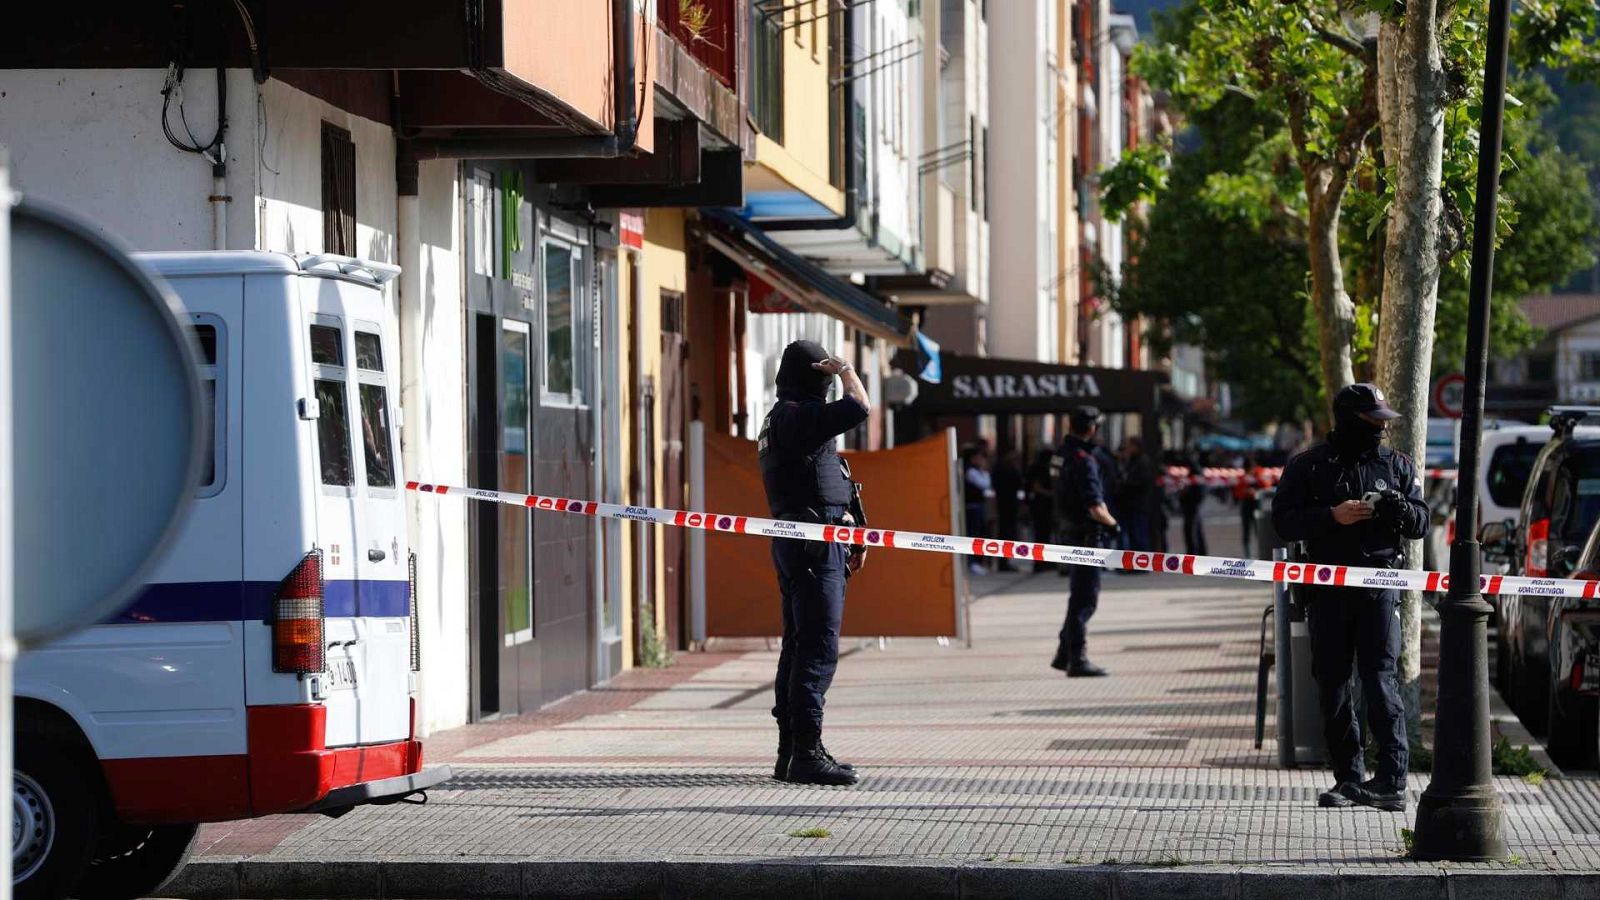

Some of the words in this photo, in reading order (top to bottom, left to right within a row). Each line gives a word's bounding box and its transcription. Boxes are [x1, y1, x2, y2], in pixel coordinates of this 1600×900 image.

[952, 374, 1100, 398] SARASUA
[625, 506, 648, 515] POLIZIA
[774, 521, 796, 529] POLIZIA
[922, 535, 945, 543] POLIZIA
[1223, 560, 1246, 568] POLIZIA
[1375, 570, 1398, 578] POLIZIA
[1363, 577, 1408, 587] UDALTZAINGOA
[1518, 586, 1564, 595] UDALTZAINGOA
